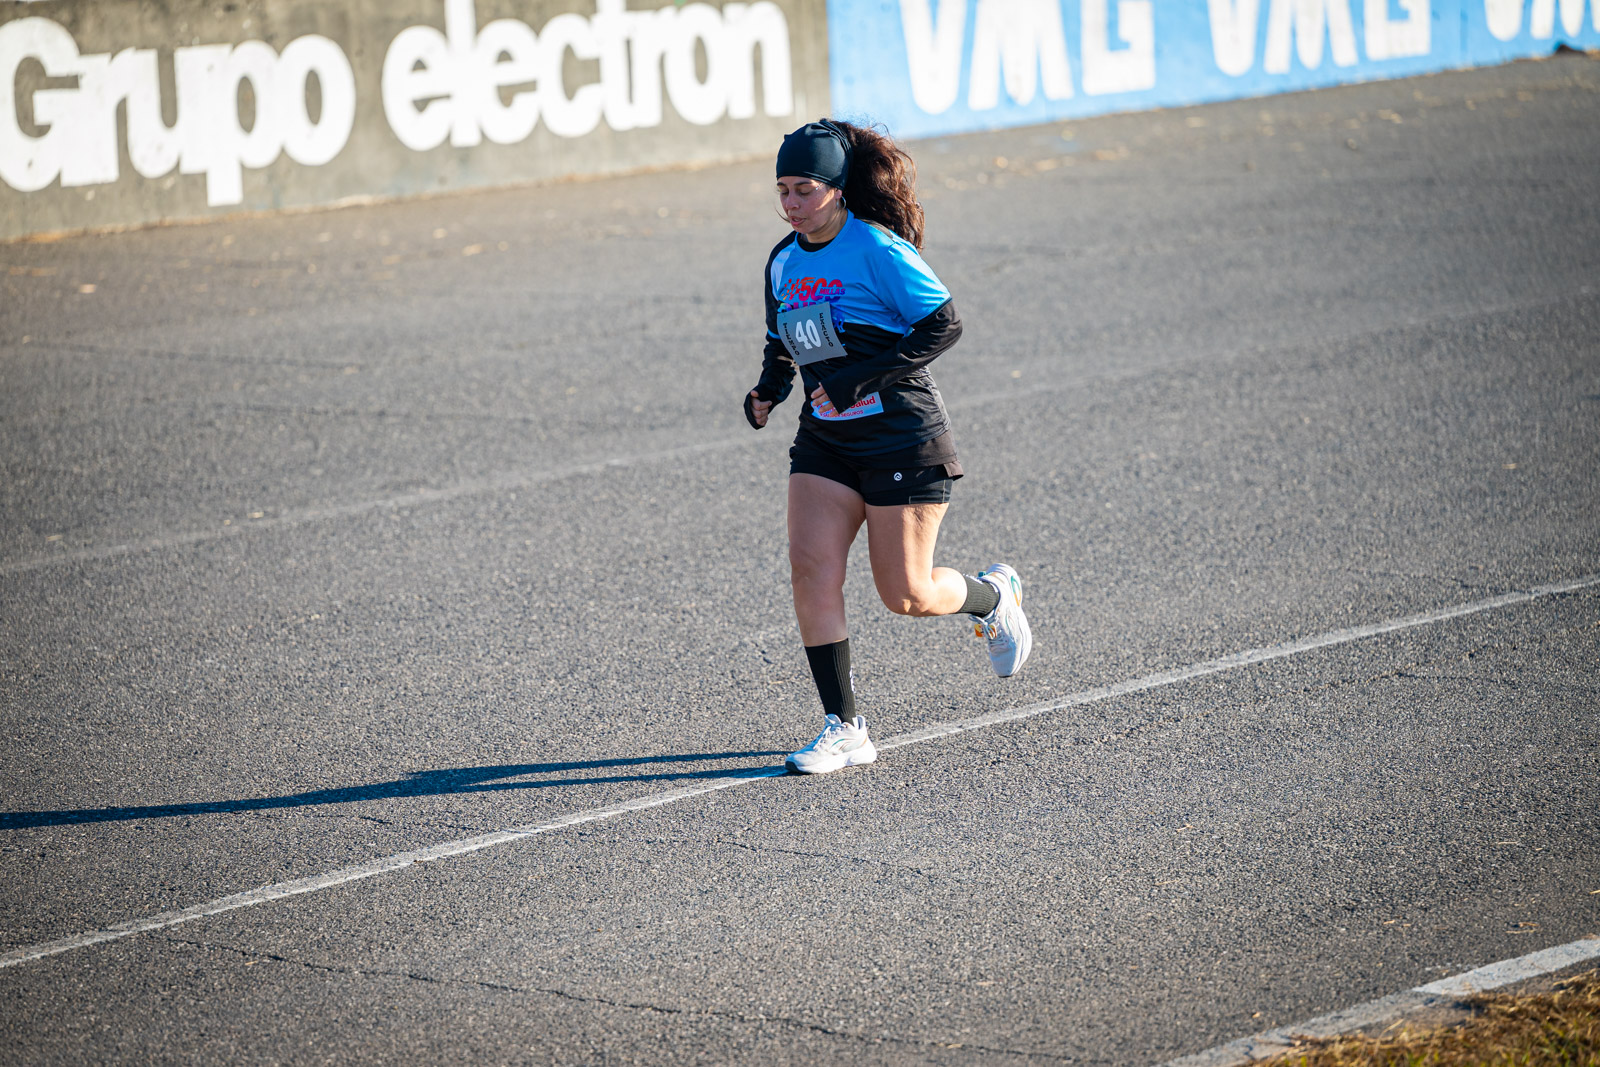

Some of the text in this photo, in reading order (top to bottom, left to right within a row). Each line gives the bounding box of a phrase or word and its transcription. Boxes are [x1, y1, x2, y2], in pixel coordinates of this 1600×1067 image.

[0, 0, 793, 206] Grupo electron
[819, 288, 846, 296] MILLAS
[795, 319, 822, 350] 40
